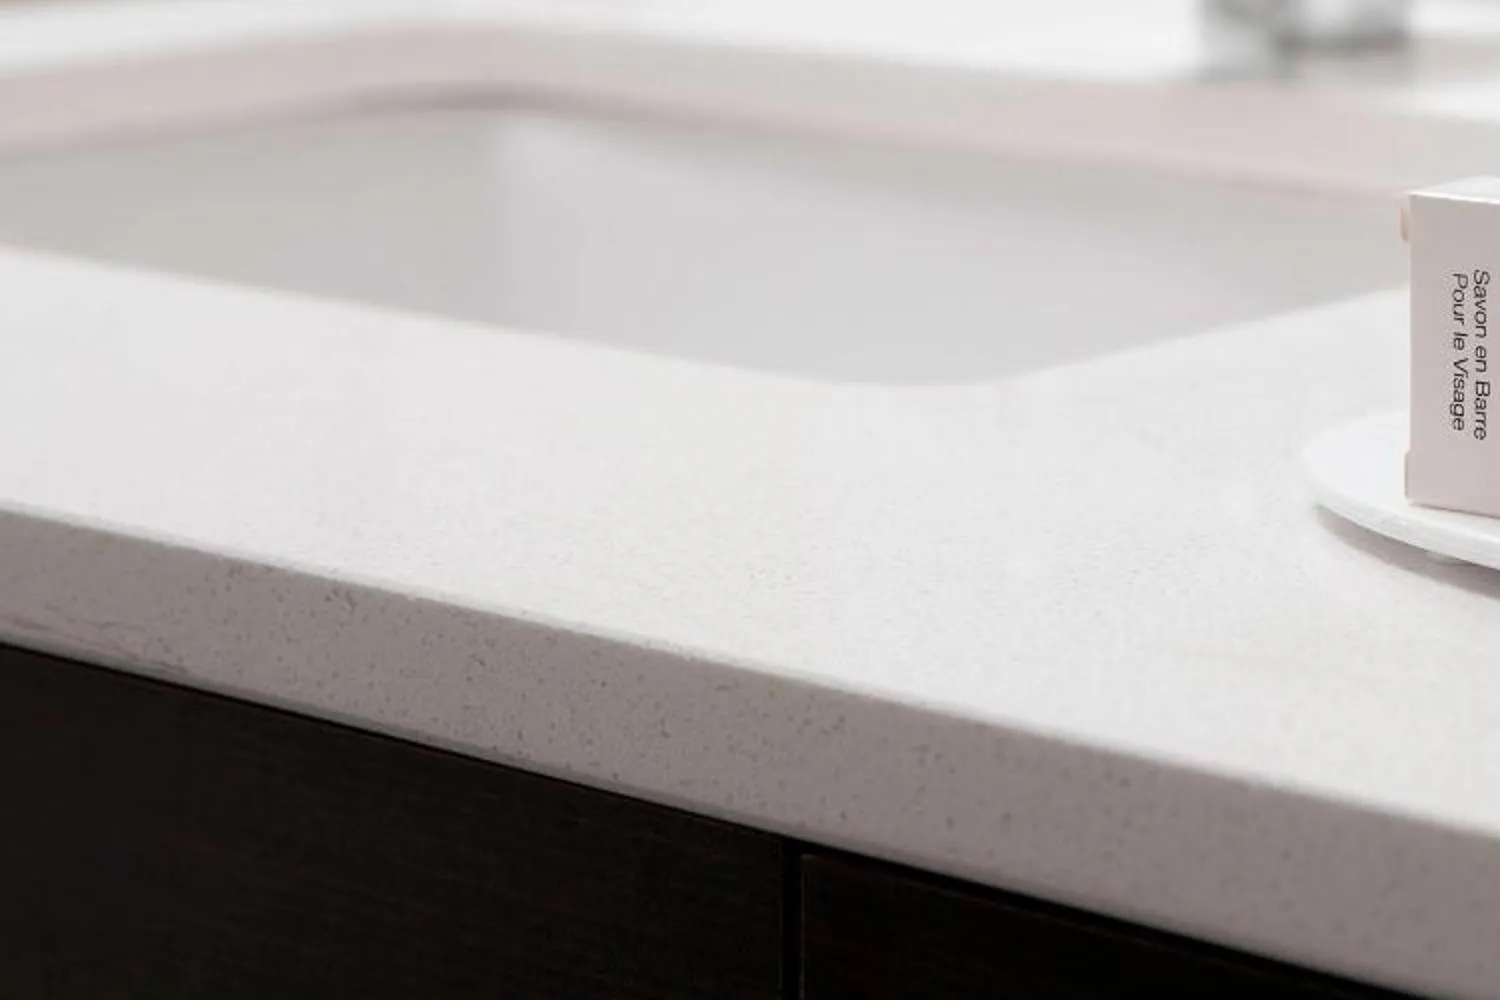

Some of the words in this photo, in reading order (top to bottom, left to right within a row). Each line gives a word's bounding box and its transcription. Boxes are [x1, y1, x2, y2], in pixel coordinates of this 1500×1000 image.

[1452, 273, 1469, 326] Pour
[1474, 269, 1491, 338] Savon
[1453, 332, 1468, 350] le
[1475, 345, 1487, 373] en
[1449, 358, 1469, 431] Visage
[1474, 381, 1490, 440] Barre
